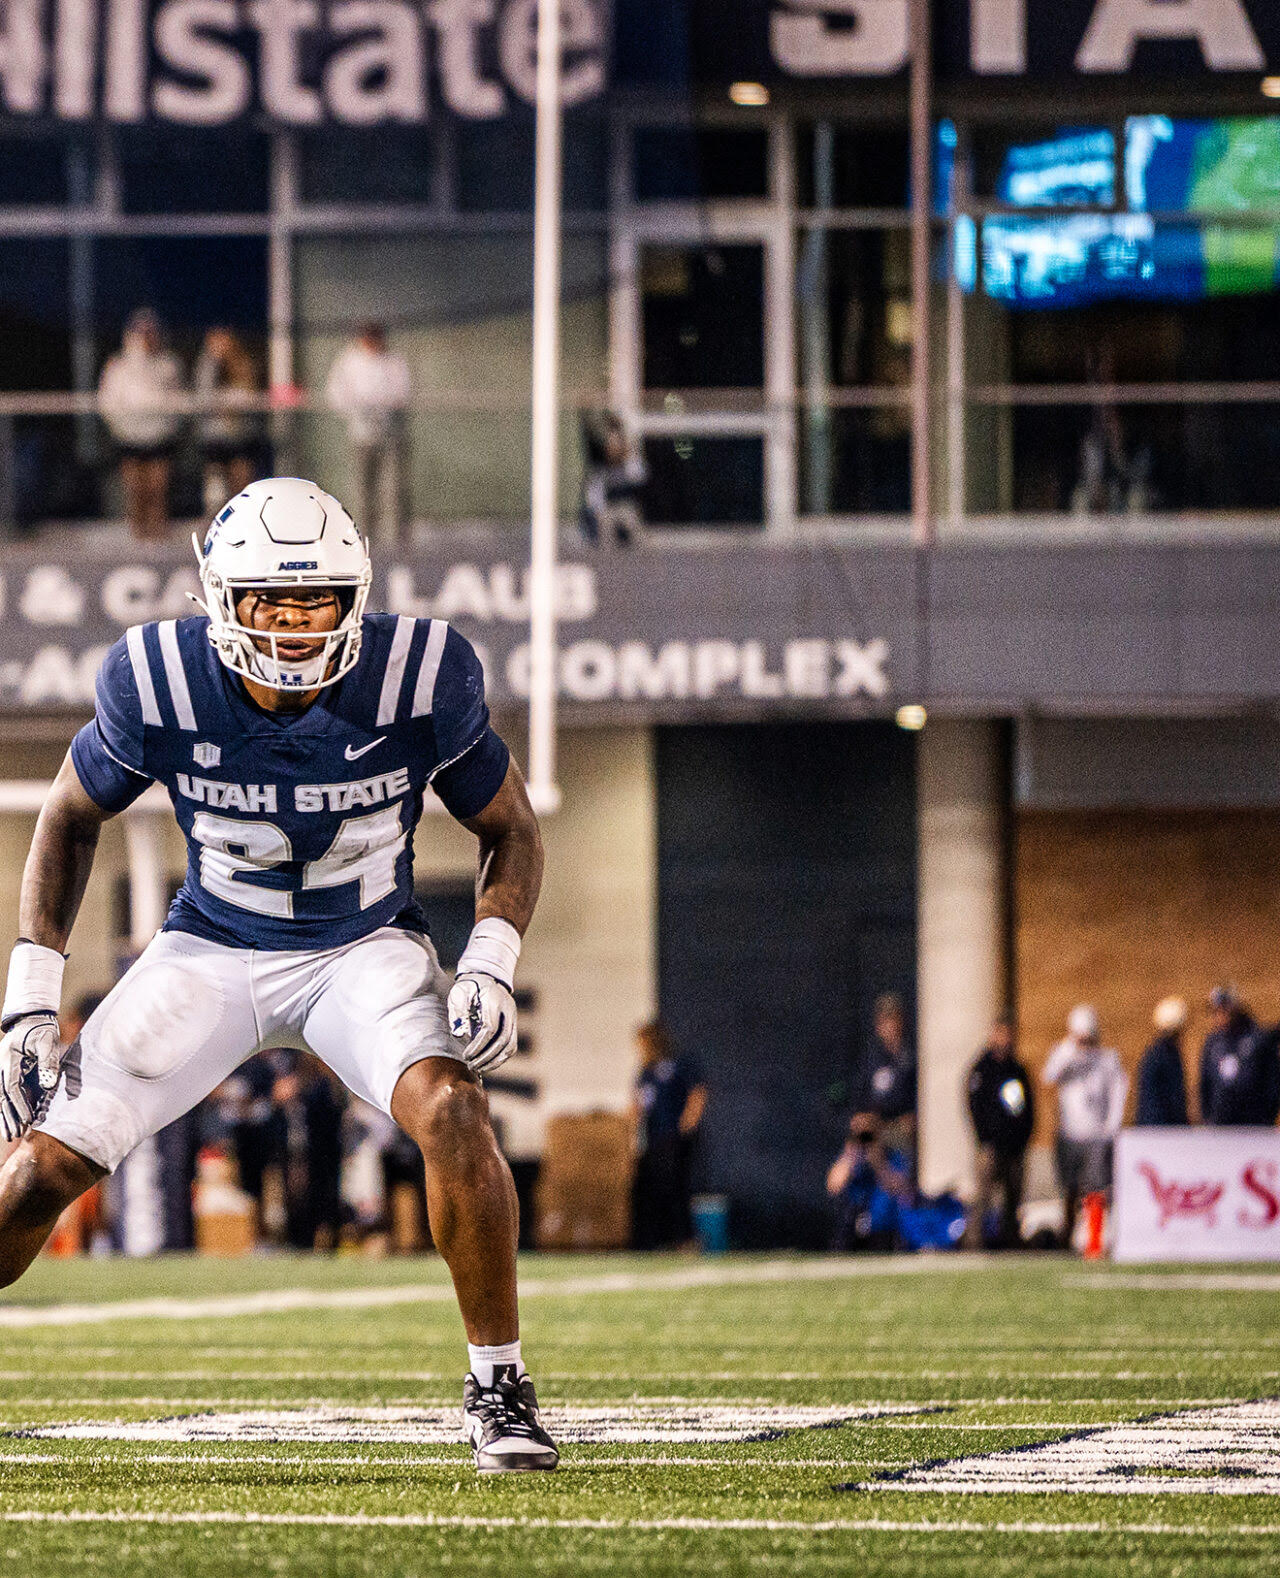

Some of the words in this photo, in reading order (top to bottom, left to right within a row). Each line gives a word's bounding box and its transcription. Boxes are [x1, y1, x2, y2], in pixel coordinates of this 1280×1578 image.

[278, 561, 318, 571] AGGIES
[22, 565, 84, 627] &
[176, 773, 277, 813] UTAH
[295, 767, 411, 813] STATE
[192, 801, 410, 919] 24
